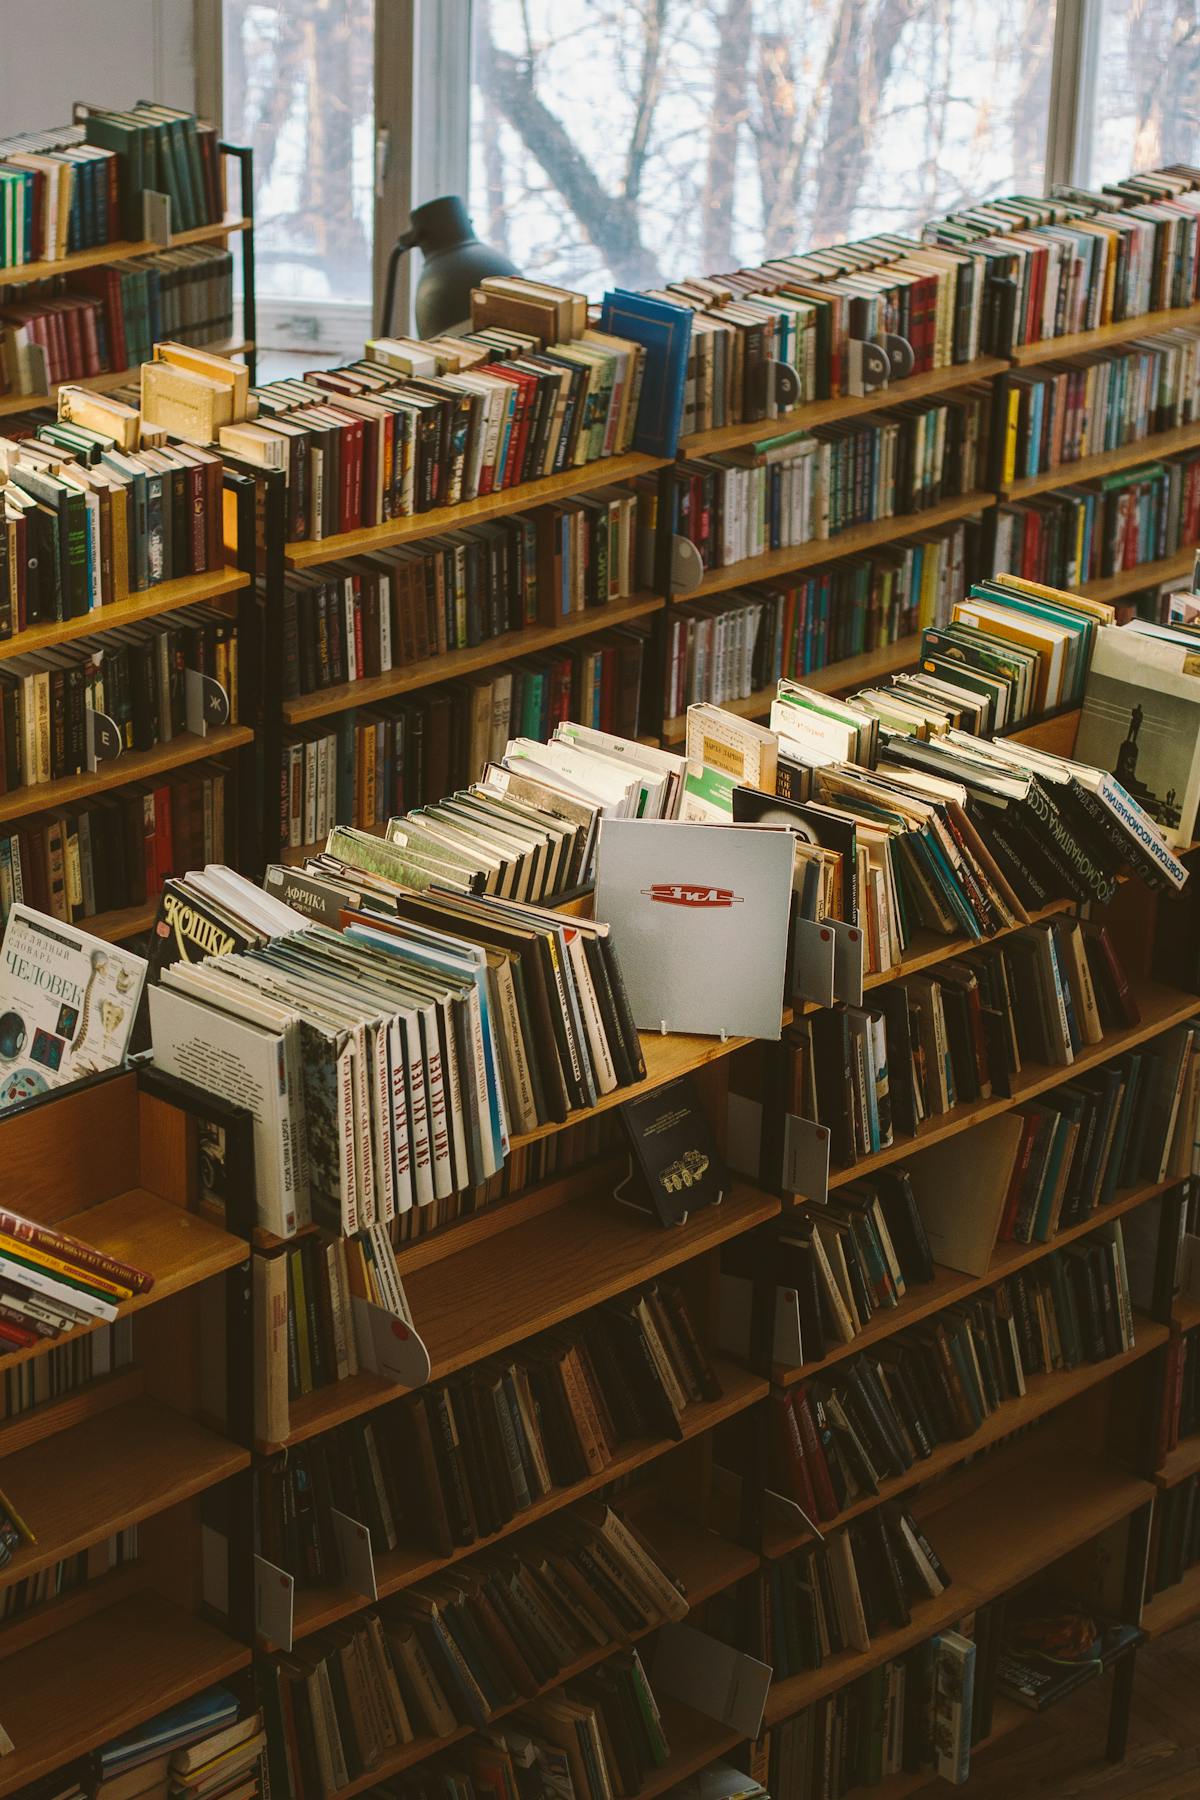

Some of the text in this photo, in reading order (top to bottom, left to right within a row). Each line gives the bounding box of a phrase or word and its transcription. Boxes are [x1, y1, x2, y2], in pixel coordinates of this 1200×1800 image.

[209, 695, 222, 712] Ж
[1102, 785, 1154, 846] КОСМОНАВТИКА
[1150, 840, 1184, 882] СОВЕТСКАЯ
[285, 885, 327, 912] АФРИКА
[163, 893, 236, 960] КОШКИ
[6, 949, 82, 1006] ЧЕЛОВЕК
[474, 1022, 485, 1070] ГОРДОСТЬ
[394, 1064, 405, 1096] ВЕК
[411, 1060, 423, 1091] ВЕК
[429, 1052, 442, 1084] ВЕК
[343, 1078, 353, 1138] ТРУДОВОЙ
[379, 1067, 389, 1127] ТРУДОВОЙ
[454, 1076, 462, 1113] НАША
[382, 1131, 392, 1192] СТРАНИЦЫ
[398, 1143, 409, 1174] ЗИЛ
[416, 1137, 429, 1168] ЗИЛ
[435, 1130, 448, 1161] ЗИЛ
[345, 1142, 355, 1204] СТРАНИЦЫ
[362, 1134, 372, 1196] СТРАНИЦЫ
[347, 1208, 357, 1231] ЗИЛ
[364, 1199, 373, 1223] ЗИЛ
[385, 1196, 393, 1215] ЗИЛ
